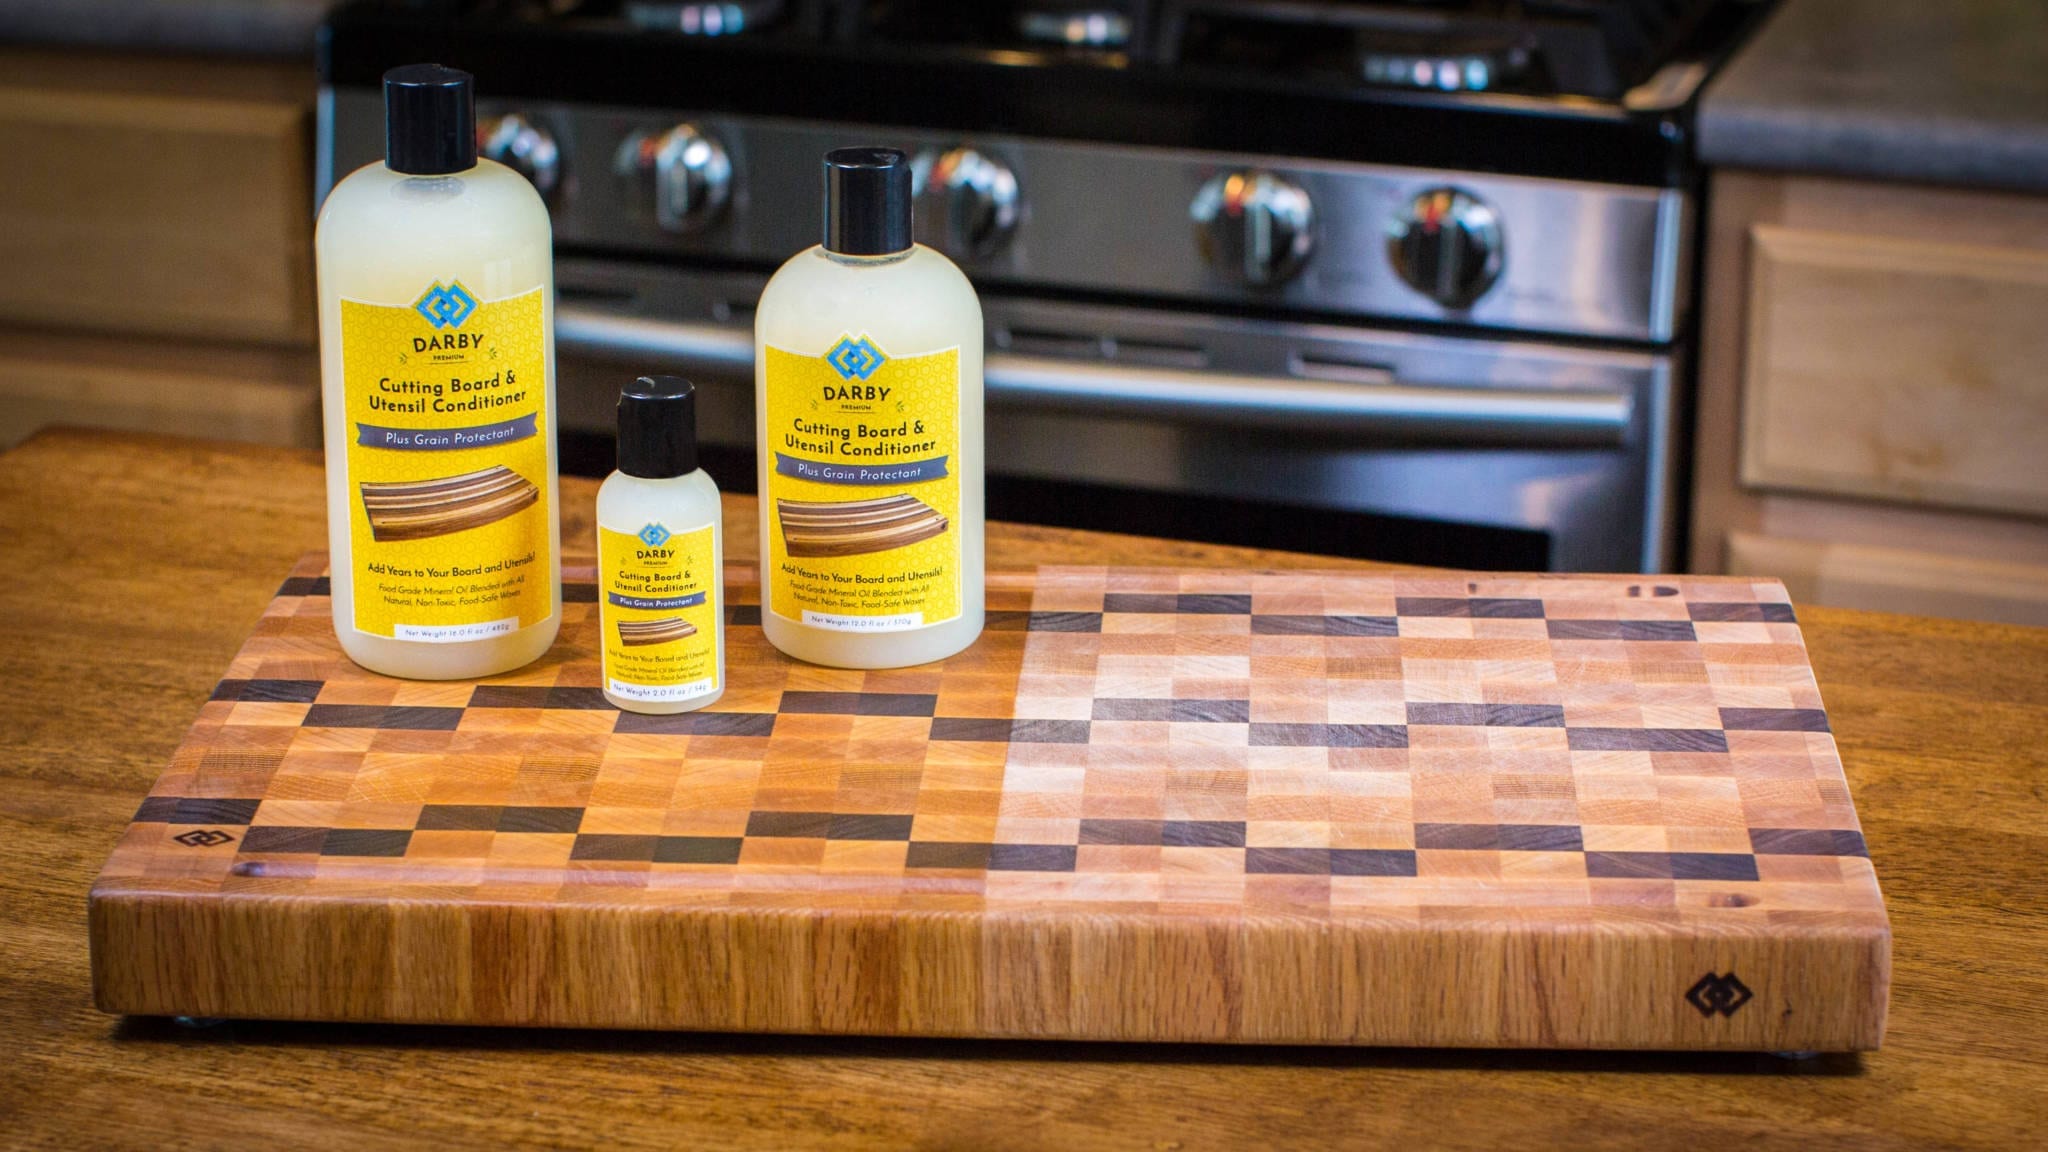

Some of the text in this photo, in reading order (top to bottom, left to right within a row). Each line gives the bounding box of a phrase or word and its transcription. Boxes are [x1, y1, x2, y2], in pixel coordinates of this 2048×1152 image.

[413, 333, 485, 353] DARBY
[379, 370, 516, 397] Cutting Board &
[823, 386, 891, 401] DARBY
[369, 391, 526, 413] Utensil Conditioner
[386, 427, 514, 445] Plus Grain Protectant
[793, 418, 925, 440] Cutting Board &
[785, 433, 936, 456] Utensil Conditioner
[798, 463, 922, 480] Plus Grain Protectant
[636, 549, 675, 560] DARBY
[367, 551, 536, 578] Add Years to Your Board and Utensils!
[619, 570, 691, 582] Cutting Board &
[781, 562, 943, 584] Add Years to Your Board and Utensils!
[379, 583, 397, 593] Food
[399, 585, 421, 595] Grade
[424, 586, 454, 596] Mineral
[456, 585, 469, 594] Oil
[470, 583, 501, 593] Blended
[615, 581, 697, 593] Utensil Conditioner
[789, 580, 930, 597] Food Grade Mineral Oil Blended with All
[460, 594, 498, 605] Food-Safe
[620, 597, 693, 608] Plus Grain Protectant
[862, 598, 901, 609] Food-Safe
[826, 618, 849, 626] Weight
[421, 630, 447, 638] Weight
[626, 687, 650, 697] Weight
